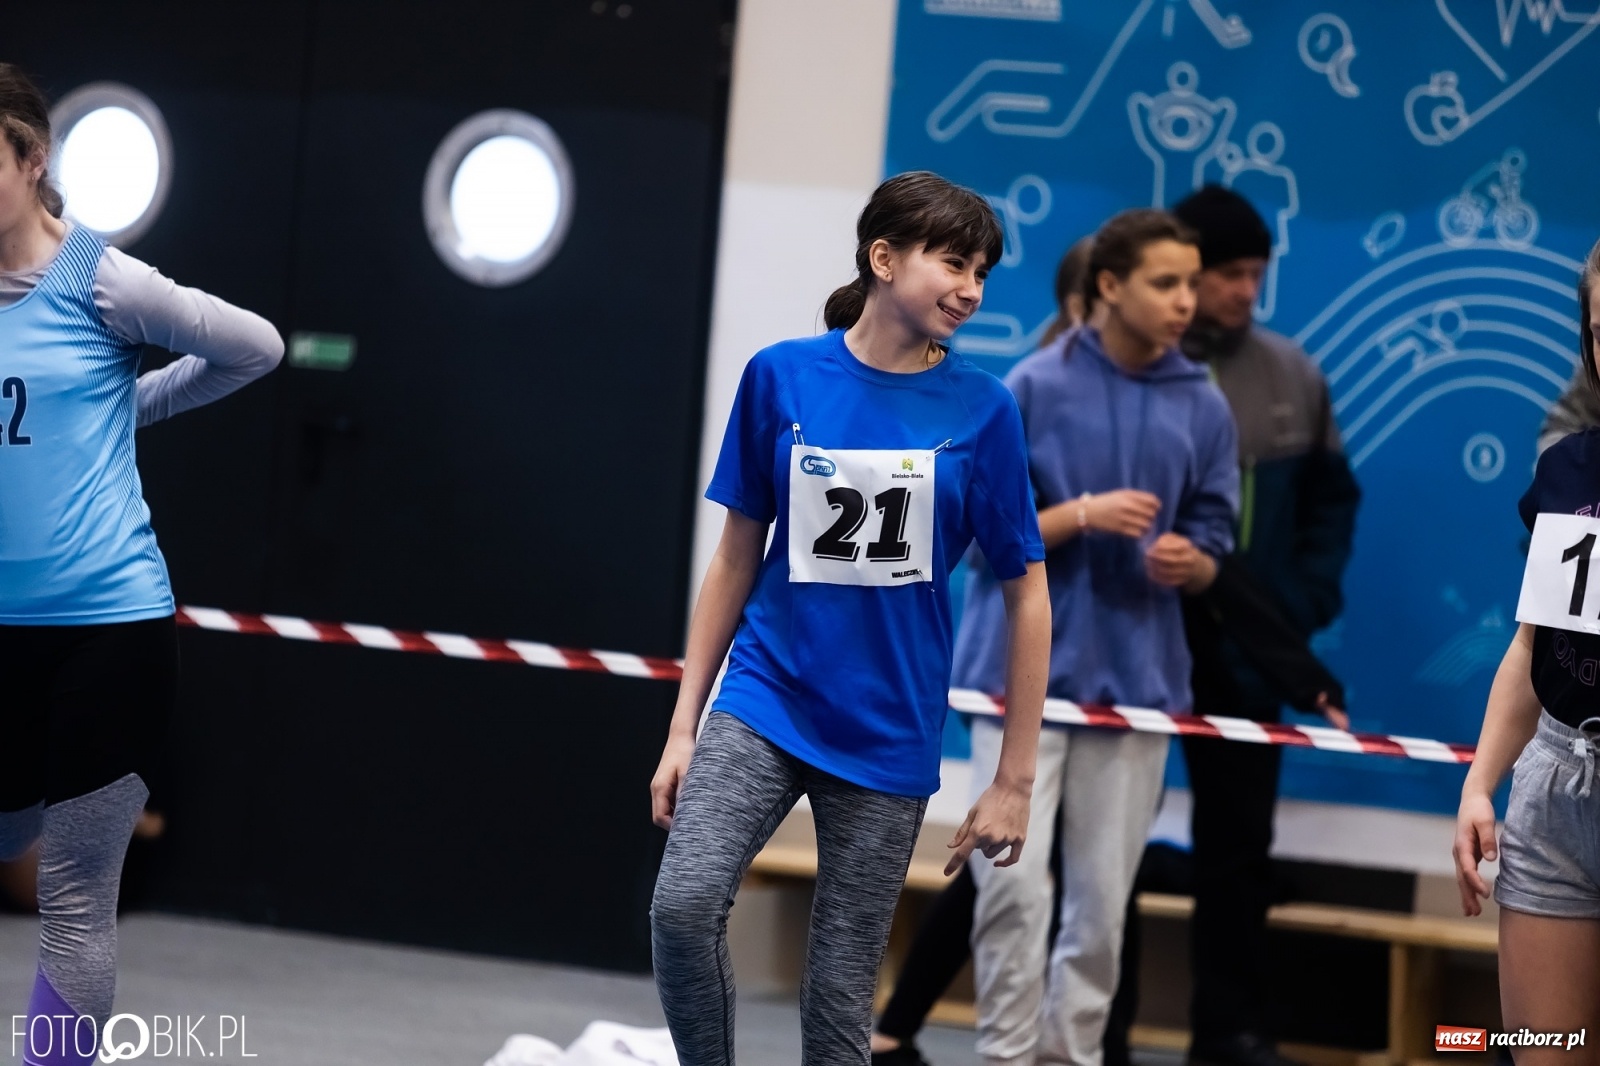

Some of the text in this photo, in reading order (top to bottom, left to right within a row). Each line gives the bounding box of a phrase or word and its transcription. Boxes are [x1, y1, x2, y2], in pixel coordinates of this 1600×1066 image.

[0, 376, 31, 446] 2
[812, 487, 911, 562] 21
[1561, 532, 1600, 620] 1
